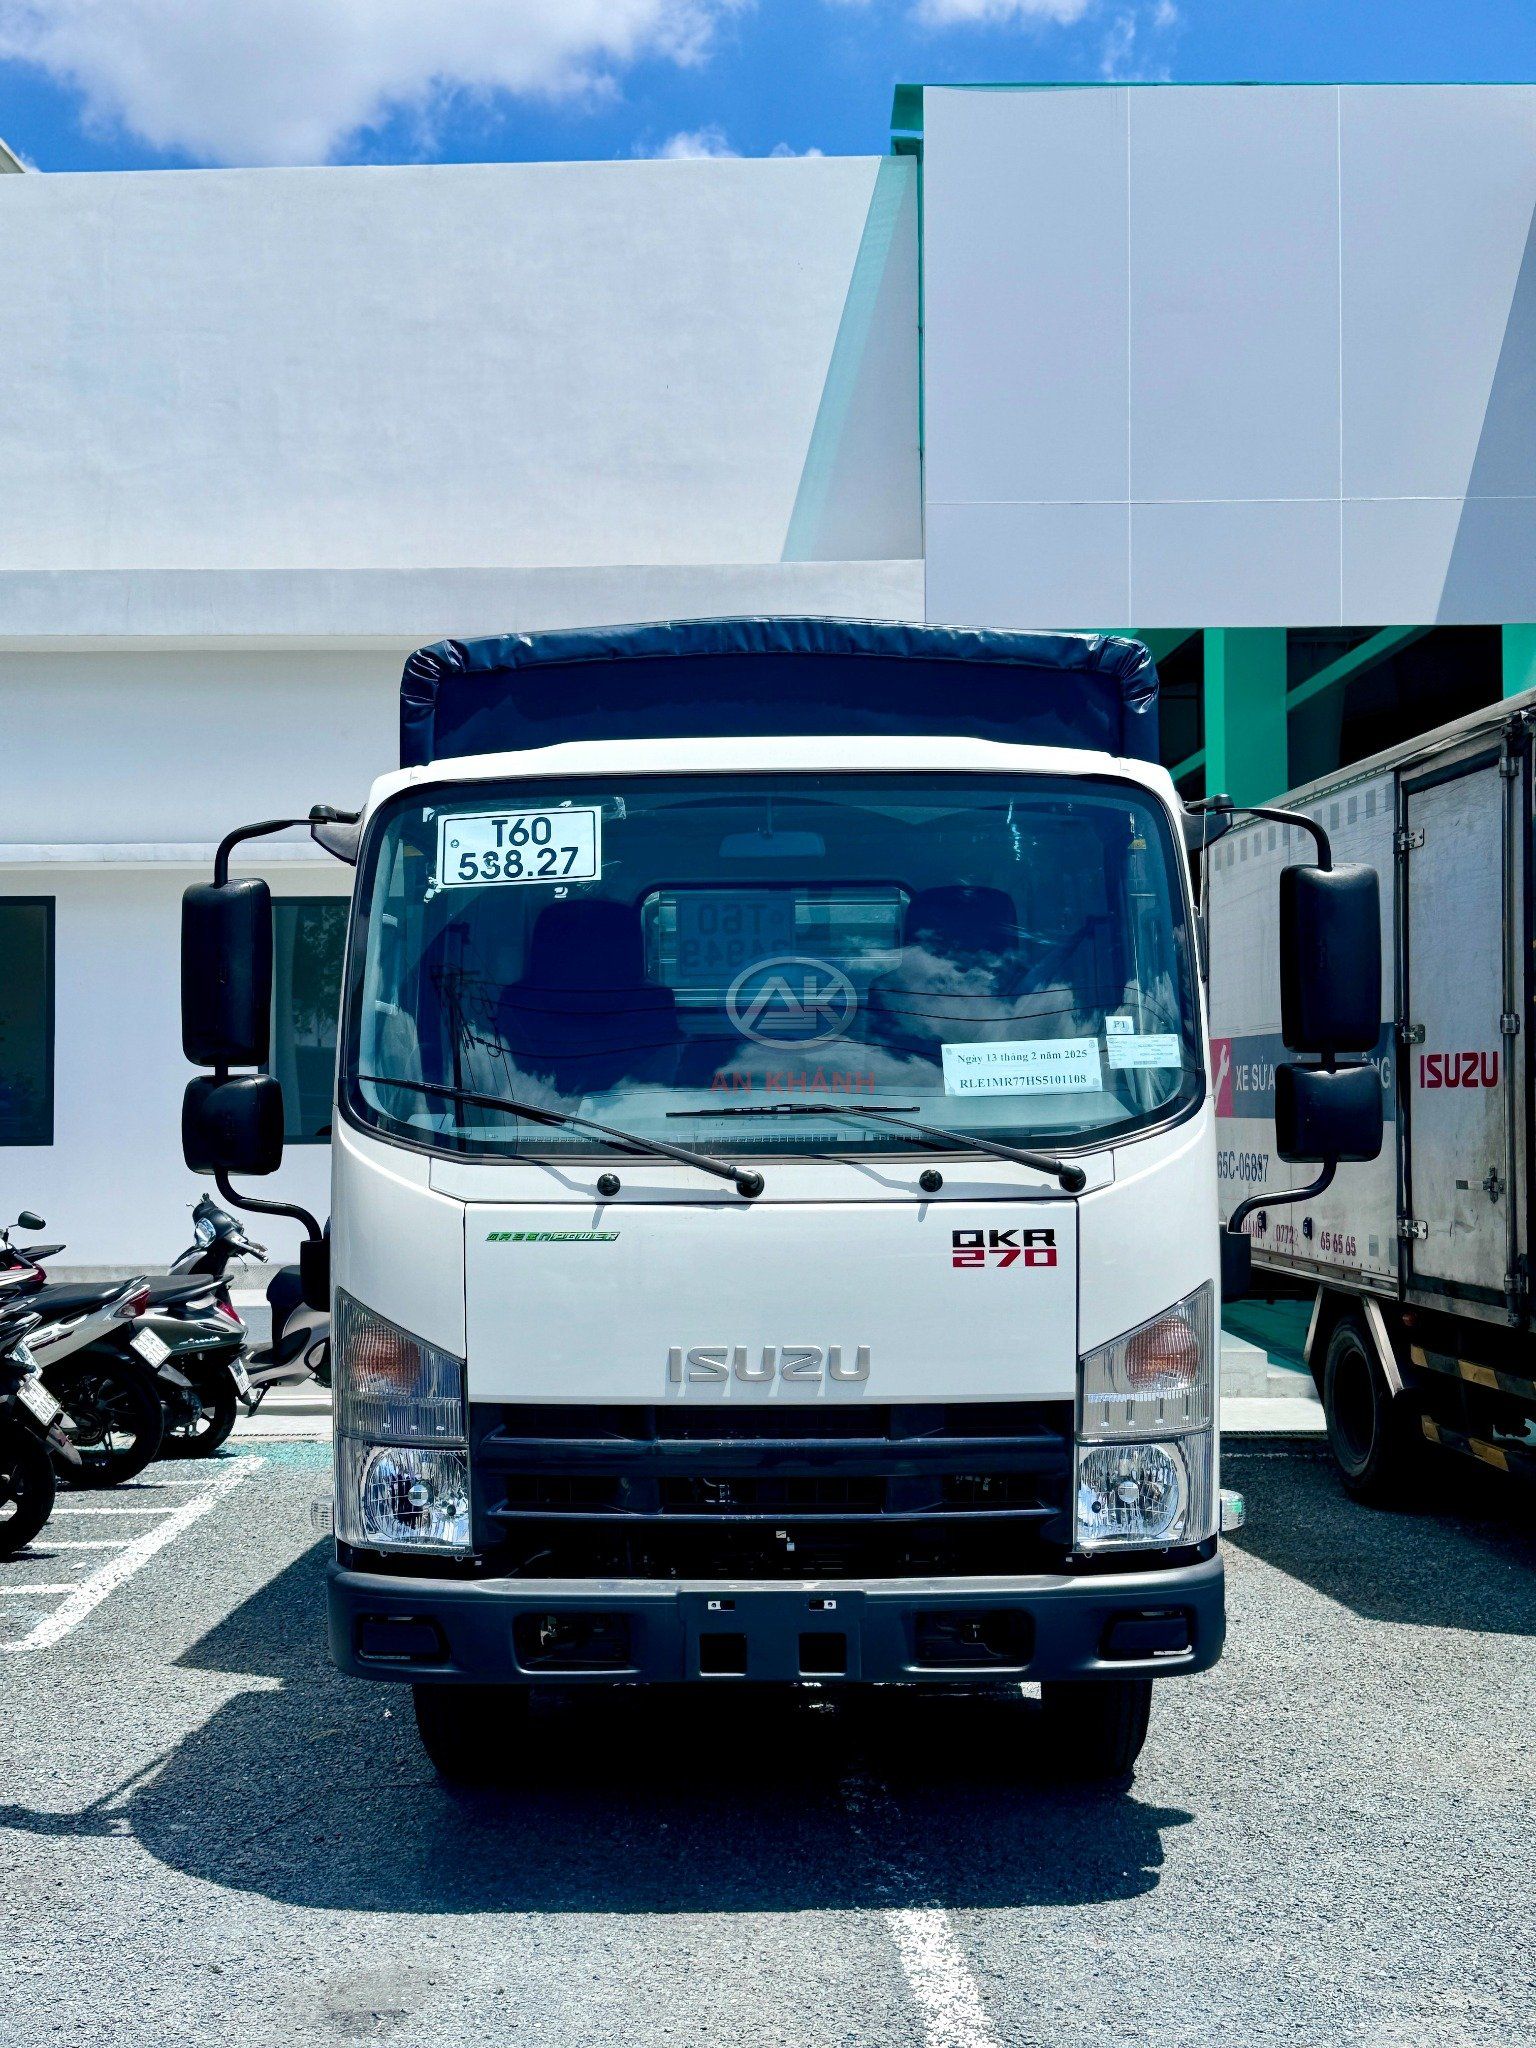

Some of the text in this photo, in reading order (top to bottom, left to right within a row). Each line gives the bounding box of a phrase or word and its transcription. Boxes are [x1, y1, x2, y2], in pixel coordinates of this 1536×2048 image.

[491, 816, 552, 848] T60
[457, 846, 579, 881] 538.27
[958, 1049, 1088, 1065] Ngày 13 tháng 2 năm 2025
[1420, 1051, 1498, 1088] ISUZU
[1235, 1065, 1249, 1091] XE
[952, 1229, 1057, 1248] QKR
[1320, 1231, 1331, 1251] 65
[1333, 1233, 1343, 1254] 65
[1345, 1235, 1356, 1257] 65
[952, 1248, 1058, 1267] 270
[668, 1345, 871, 1382] ISUZU
